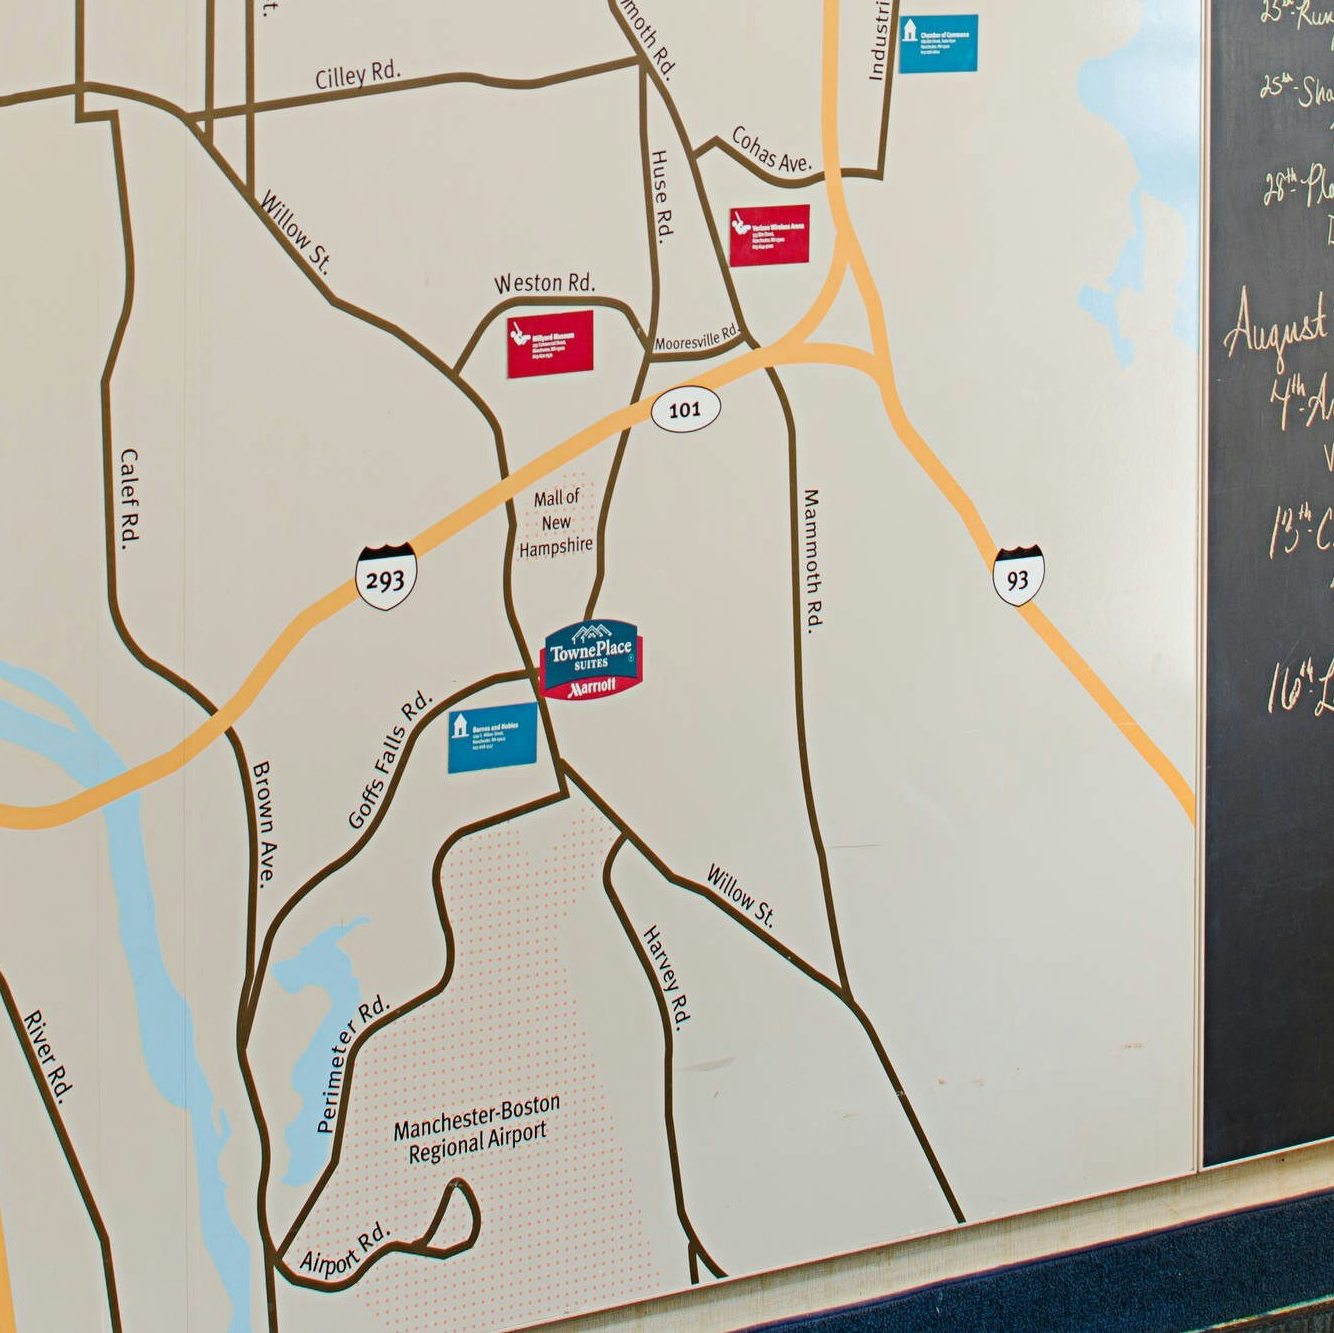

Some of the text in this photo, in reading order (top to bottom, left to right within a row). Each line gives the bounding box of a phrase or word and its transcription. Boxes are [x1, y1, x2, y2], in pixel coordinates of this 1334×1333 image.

[534, 487, 581, 507] Mall of
[542, 514, 571, 531] New
[519, 535, 593, 560] Hampshire
[550, 639, 632, 663] TownePlace
[574, 658, 609, 671] SUITES
[567, 677, 617, 699] Marriott
[349, 691, 433, 830] Goffs Falls Rd.
[317, 994, 391, 1135] Perimeter Rd.
[393, 1094, 561, 1143] Manchester-Boston
[409, 1120, 547, 1165] Regional Airport
